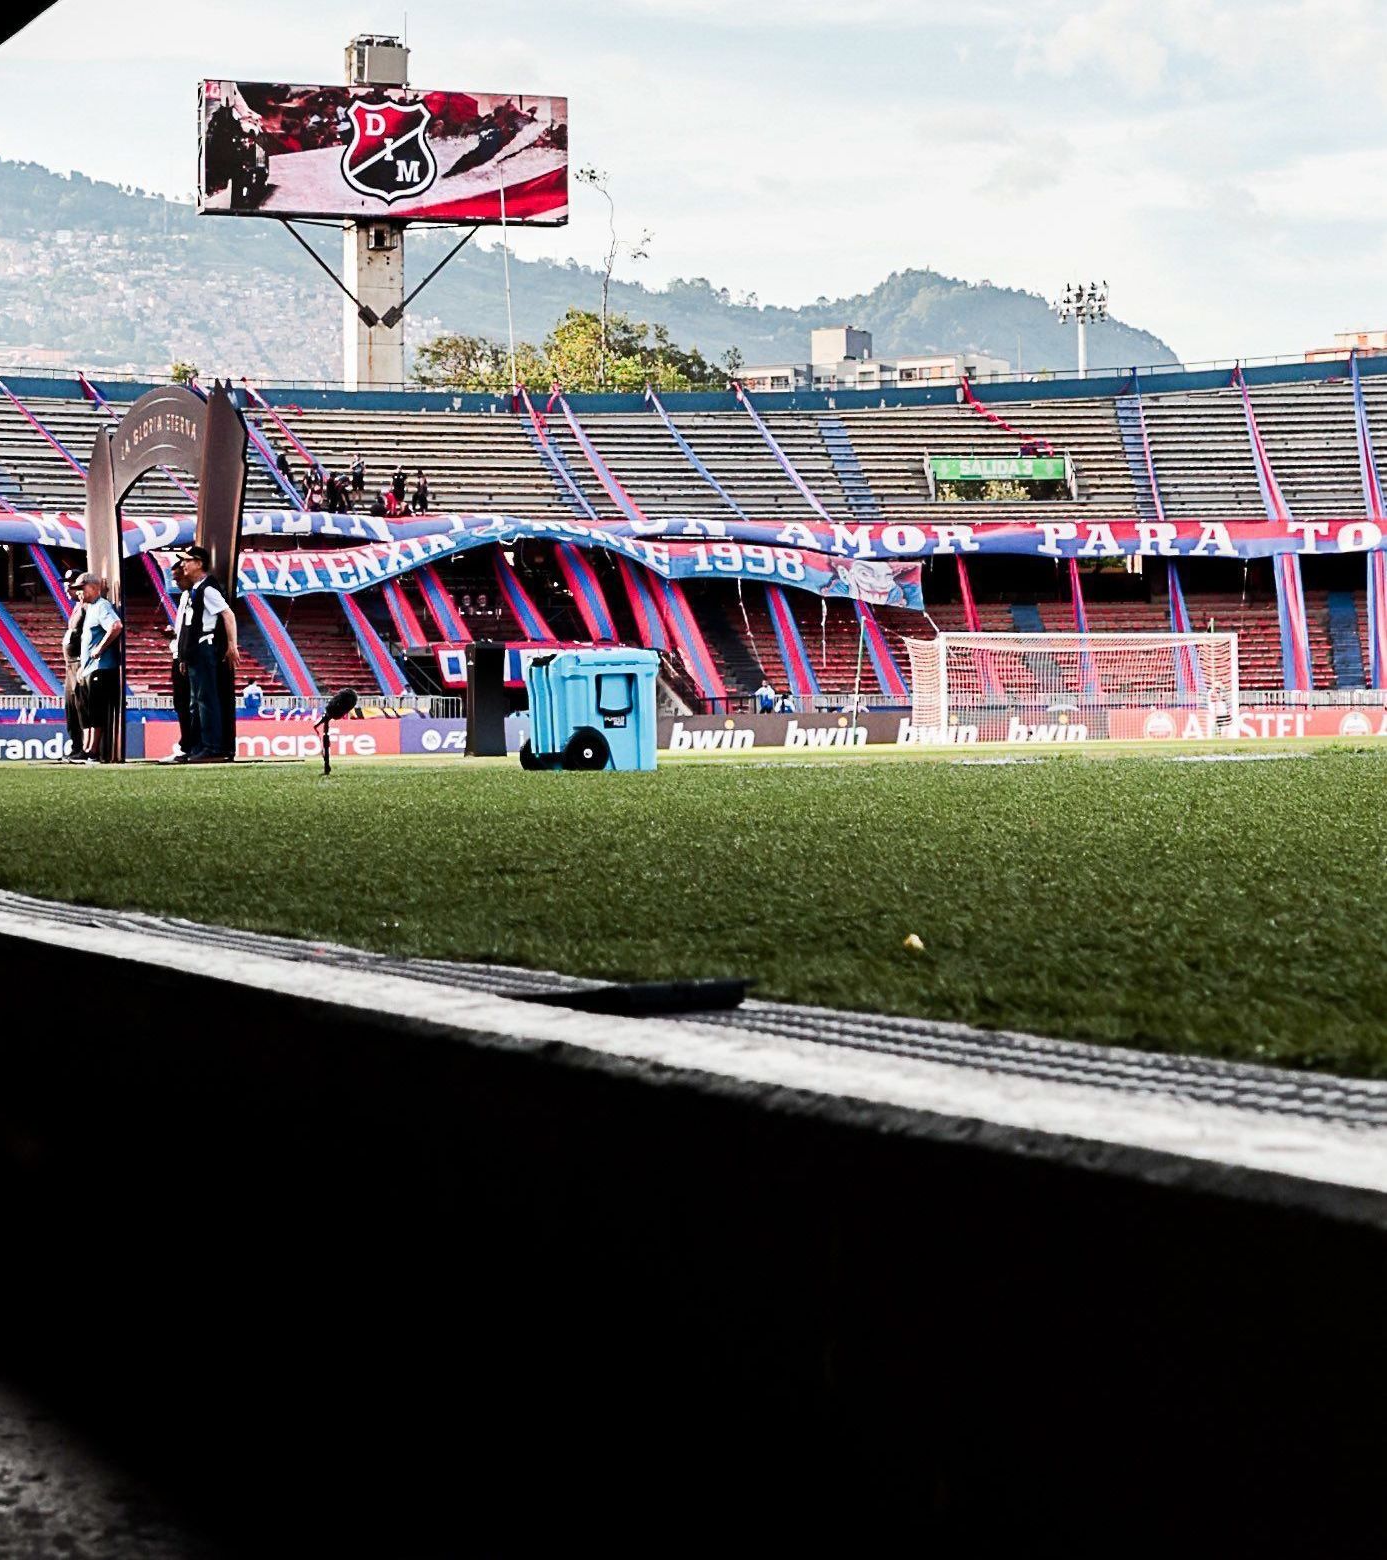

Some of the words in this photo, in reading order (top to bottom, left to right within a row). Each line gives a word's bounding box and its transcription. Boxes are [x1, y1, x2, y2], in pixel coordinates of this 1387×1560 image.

[960, 459, 1020, 475] SALIDA
[1022, 459, 1034, 474] 3
[776, 521, 979, 559] AMOR
[1036, 521, 1238, 557] PARA
[1288, 519, 1382, 555] TO
[693, 542, 806, 582] 1998
[235, 728, 377, 757] mapfre
[669, 719, 755, 750] bwin
[785, 716, 868, 748] bwin
[896, 714, 979, 746] bwin
[1007, 714, 1088, 744] bwin
